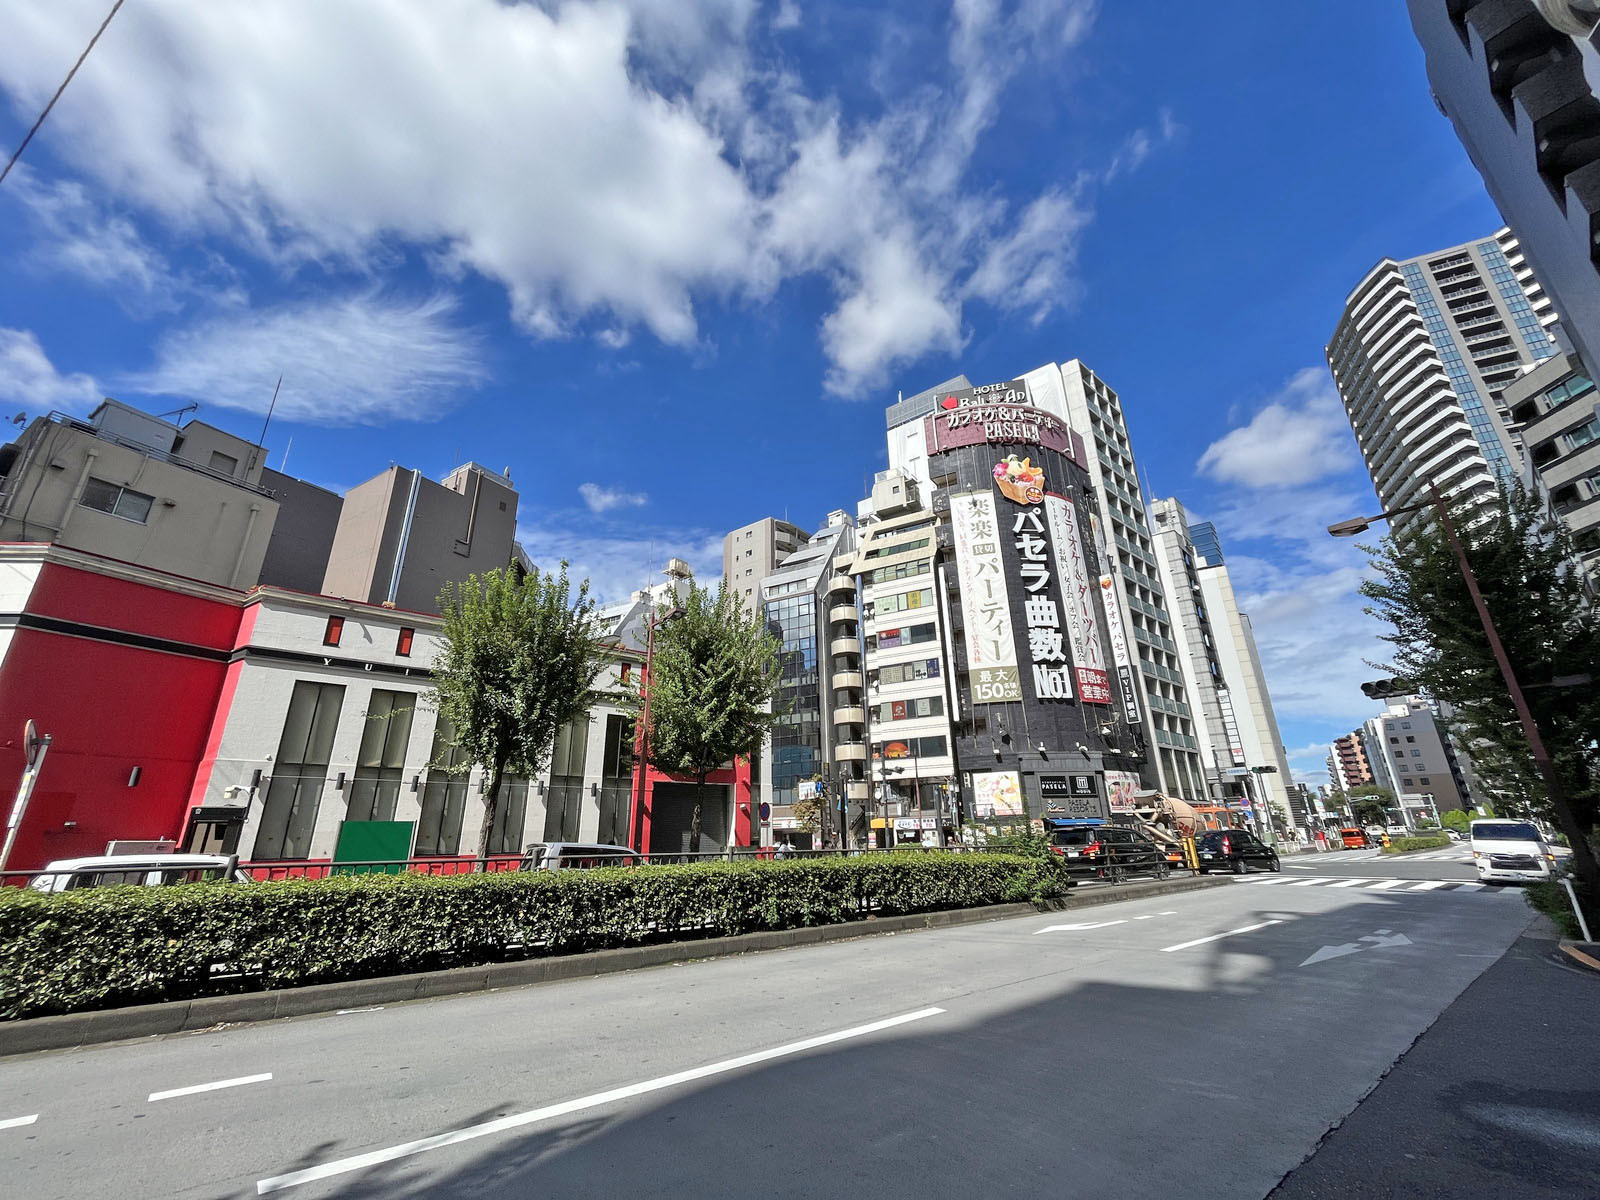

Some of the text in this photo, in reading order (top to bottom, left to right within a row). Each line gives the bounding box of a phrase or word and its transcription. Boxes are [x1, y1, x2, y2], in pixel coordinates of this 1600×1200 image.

[973, 382, 1008, 395] HOTEL
[1004, 389, 1025, 402] An
[975, 557, 1003, 660] パーティー
[1105, 592, 1119, 629] カラオケ
[980, 669, 1008, 682] 最大
[974, 682, 1004, 699] 150
[1004, 690, 1019, 698] OK
